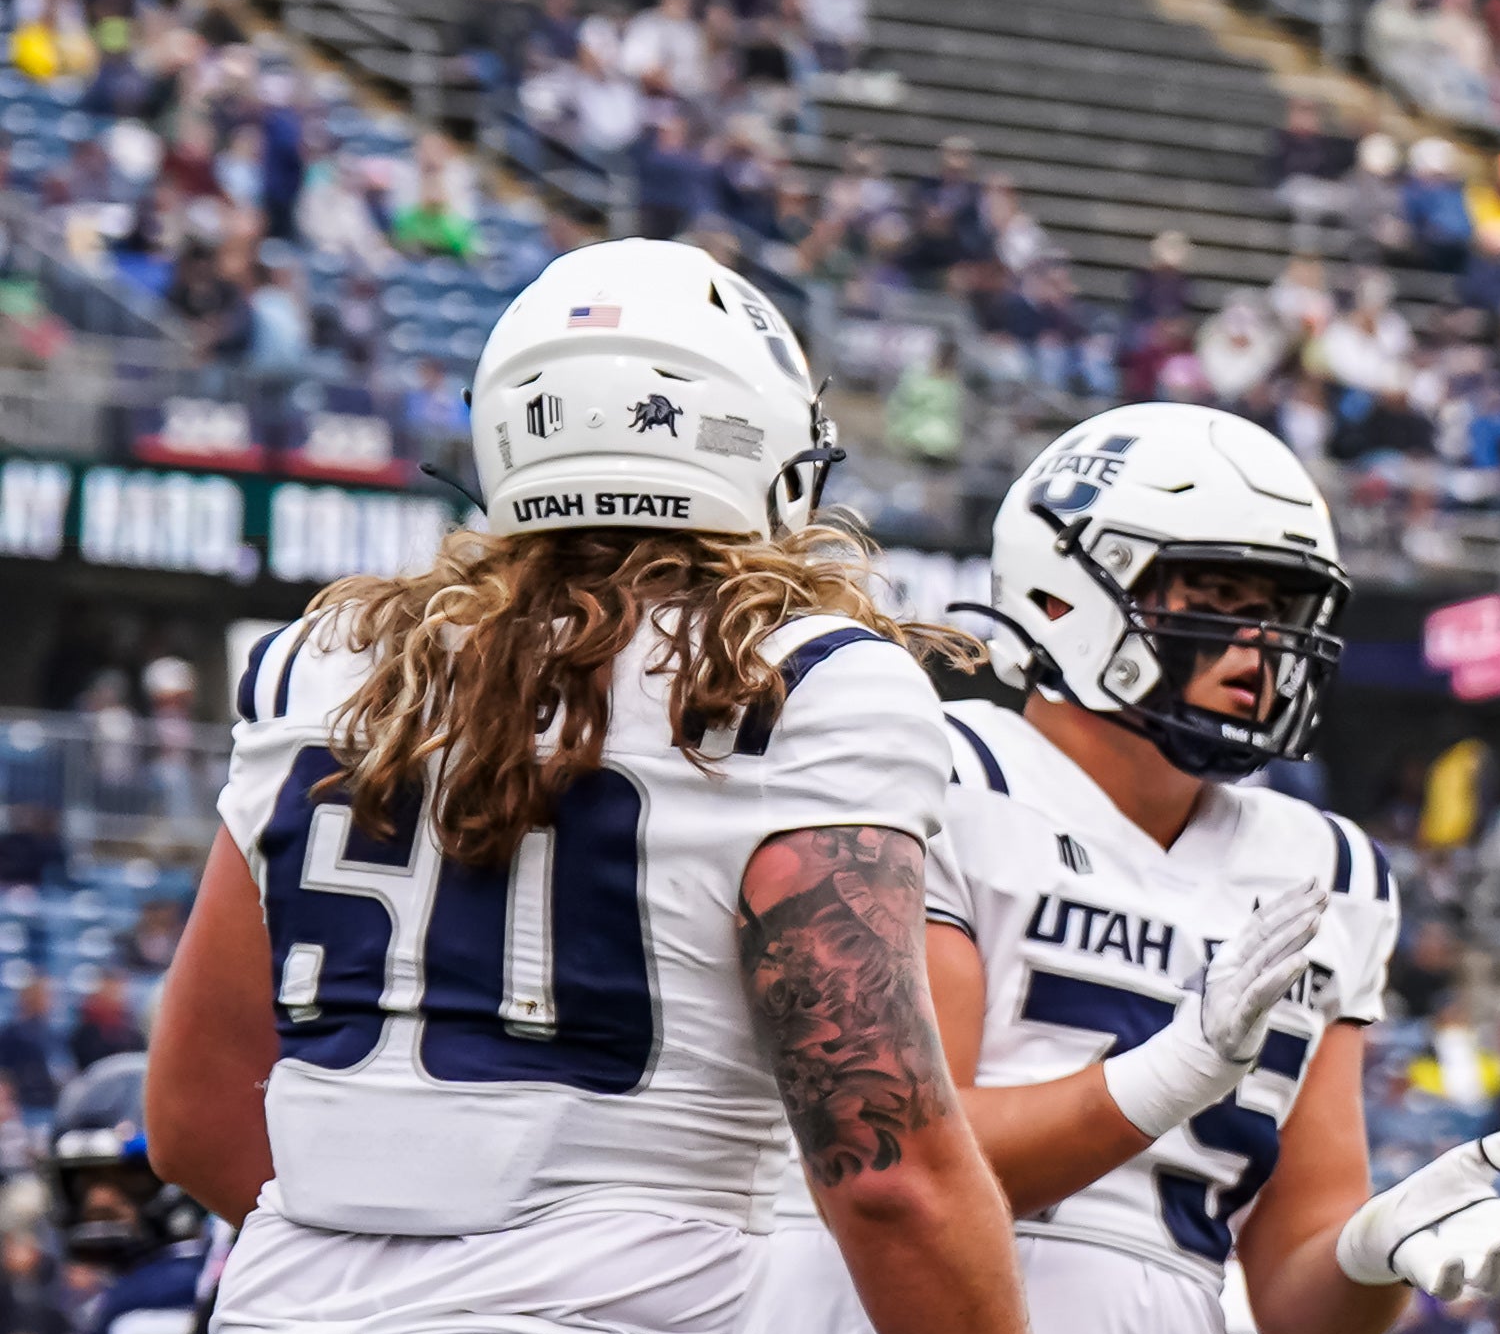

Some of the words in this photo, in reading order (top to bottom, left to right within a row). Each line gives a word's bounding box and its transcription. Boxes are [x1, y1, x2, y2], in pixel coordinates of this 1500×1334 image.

[512, 493, 585, 523] UTAH
[595, 492, 691, 520] STATE
[1024, 893, 1174, 971] UTAH
